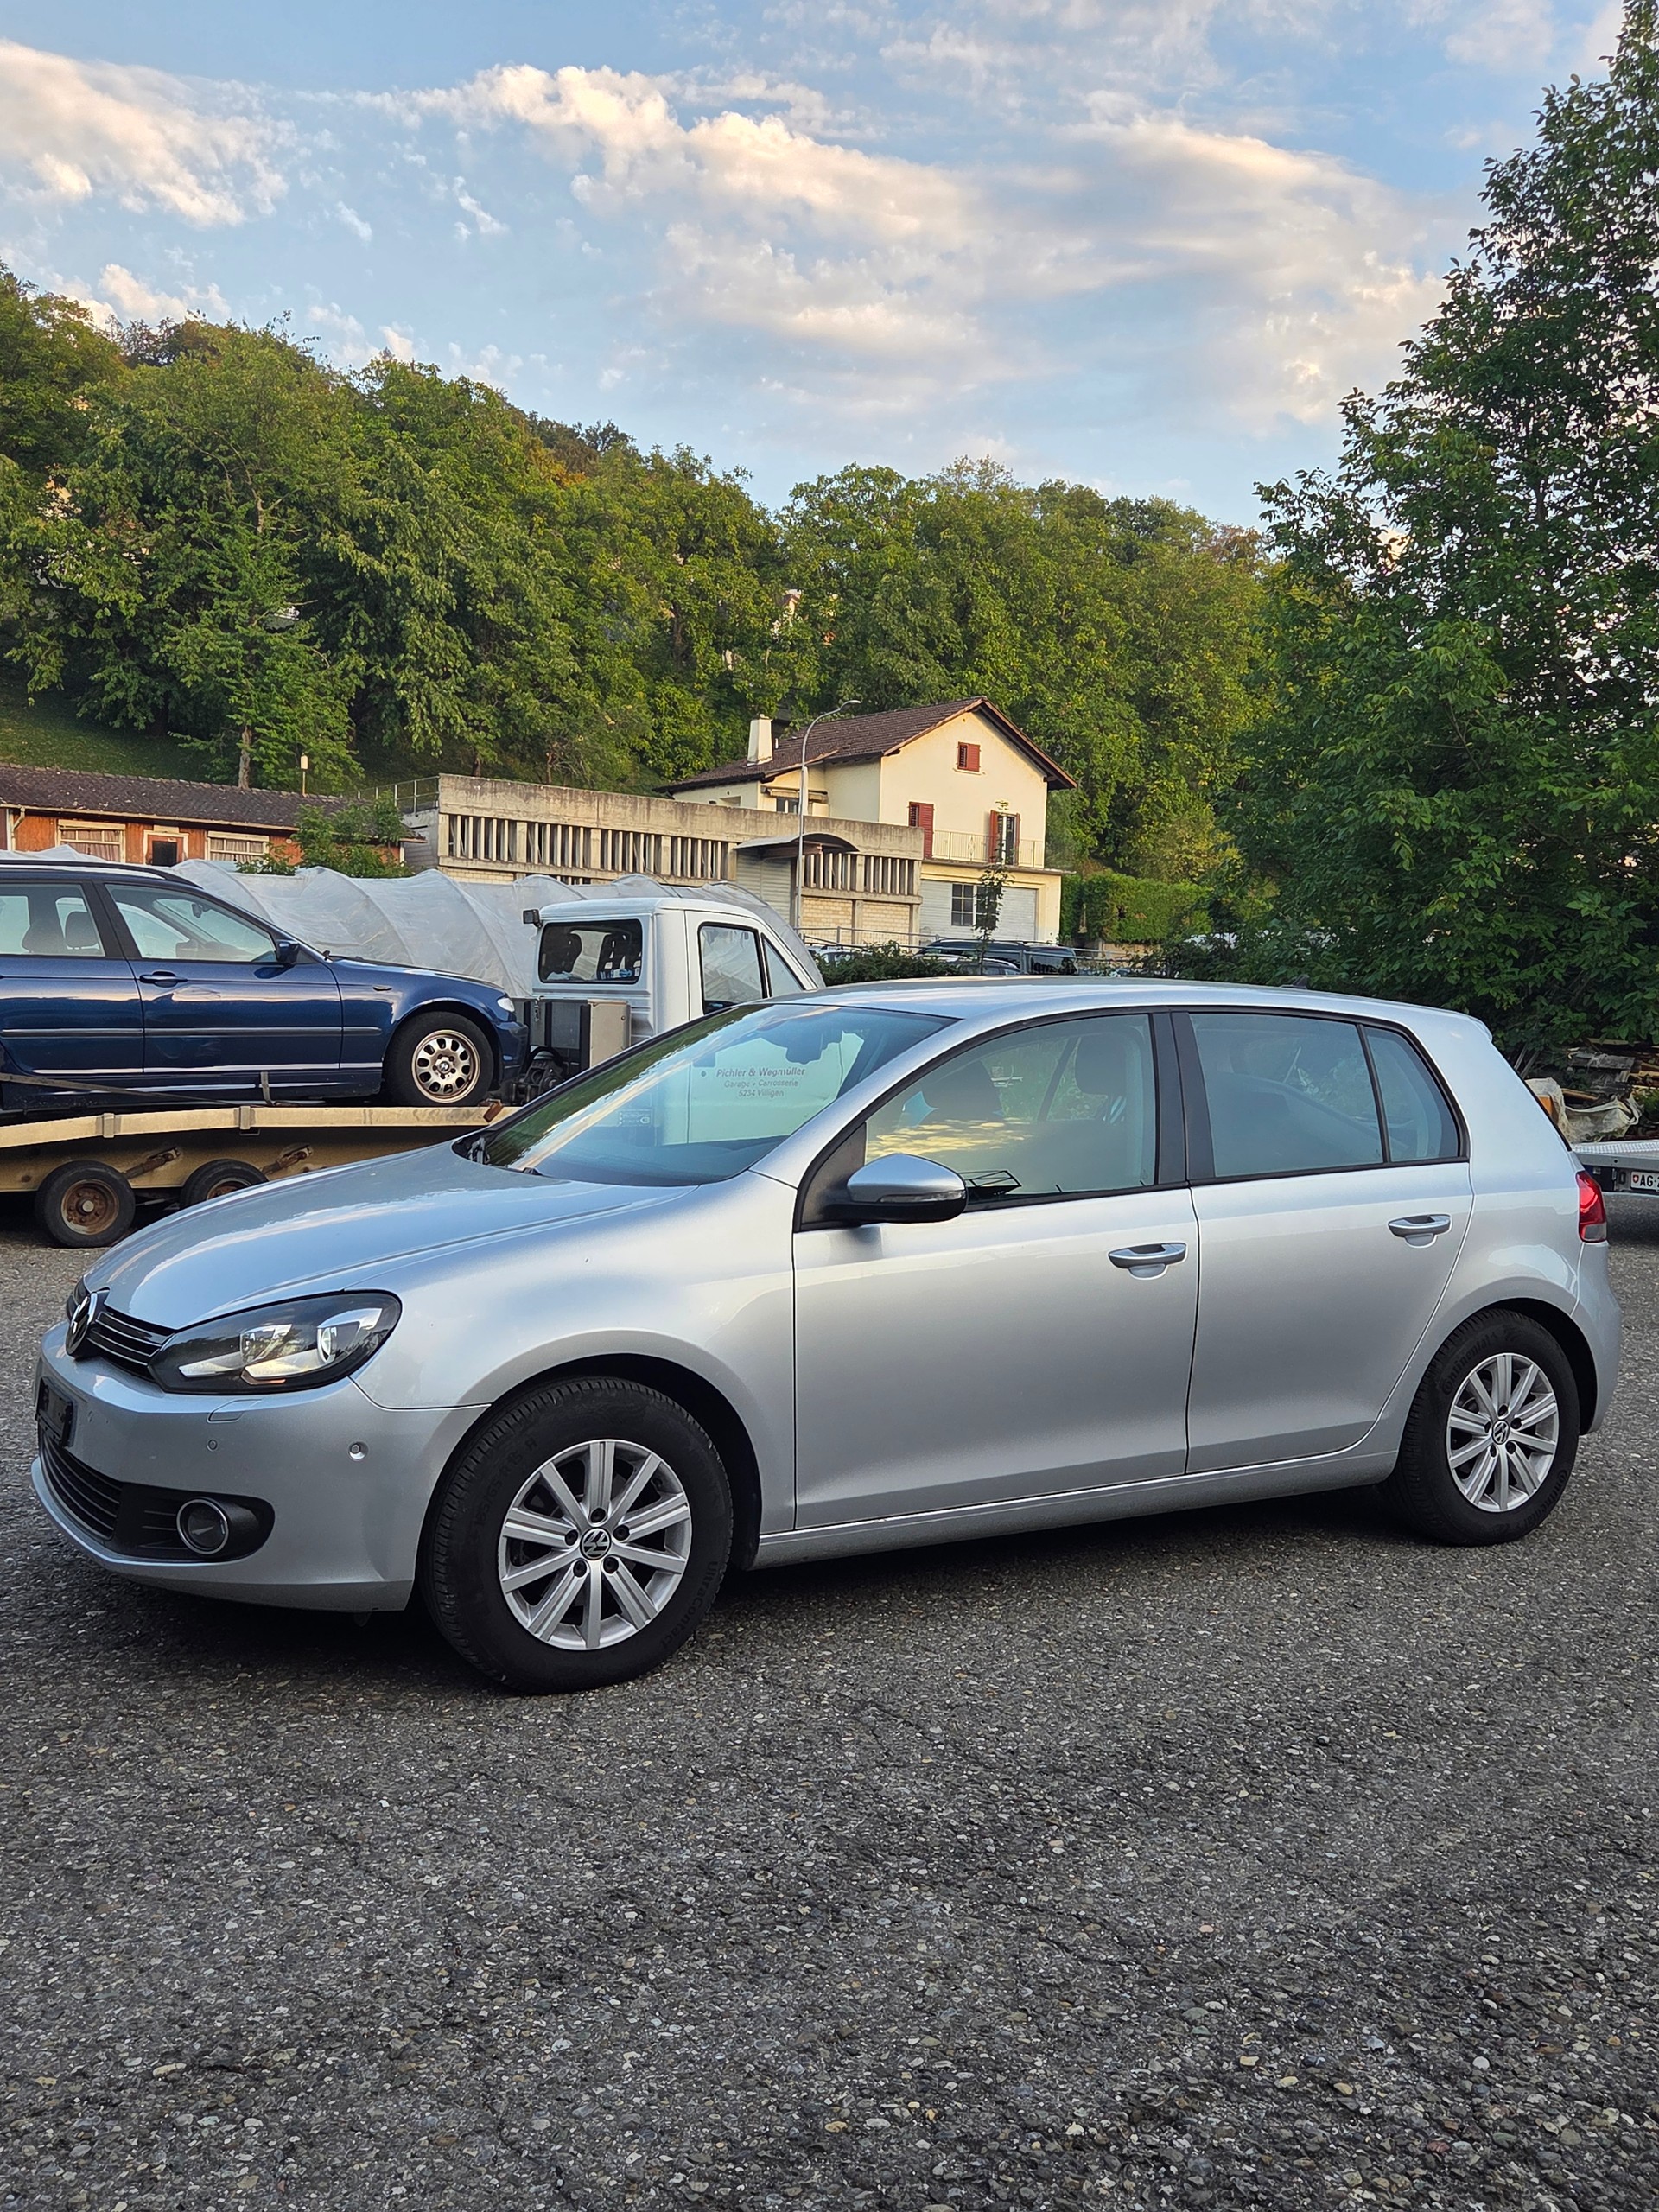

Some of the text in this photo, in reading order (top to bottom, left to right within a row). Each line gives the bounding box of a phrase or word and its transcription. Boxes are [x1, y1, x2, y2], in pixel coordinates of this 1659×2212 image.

[716, 1066, 805, 1077] Pichler & Wegmüller
[724, 1079, 750, 1089] Garage
[758, 1078, 798, 1088] Carrosserie
[757, 1089, 785, 1098] Villigen
